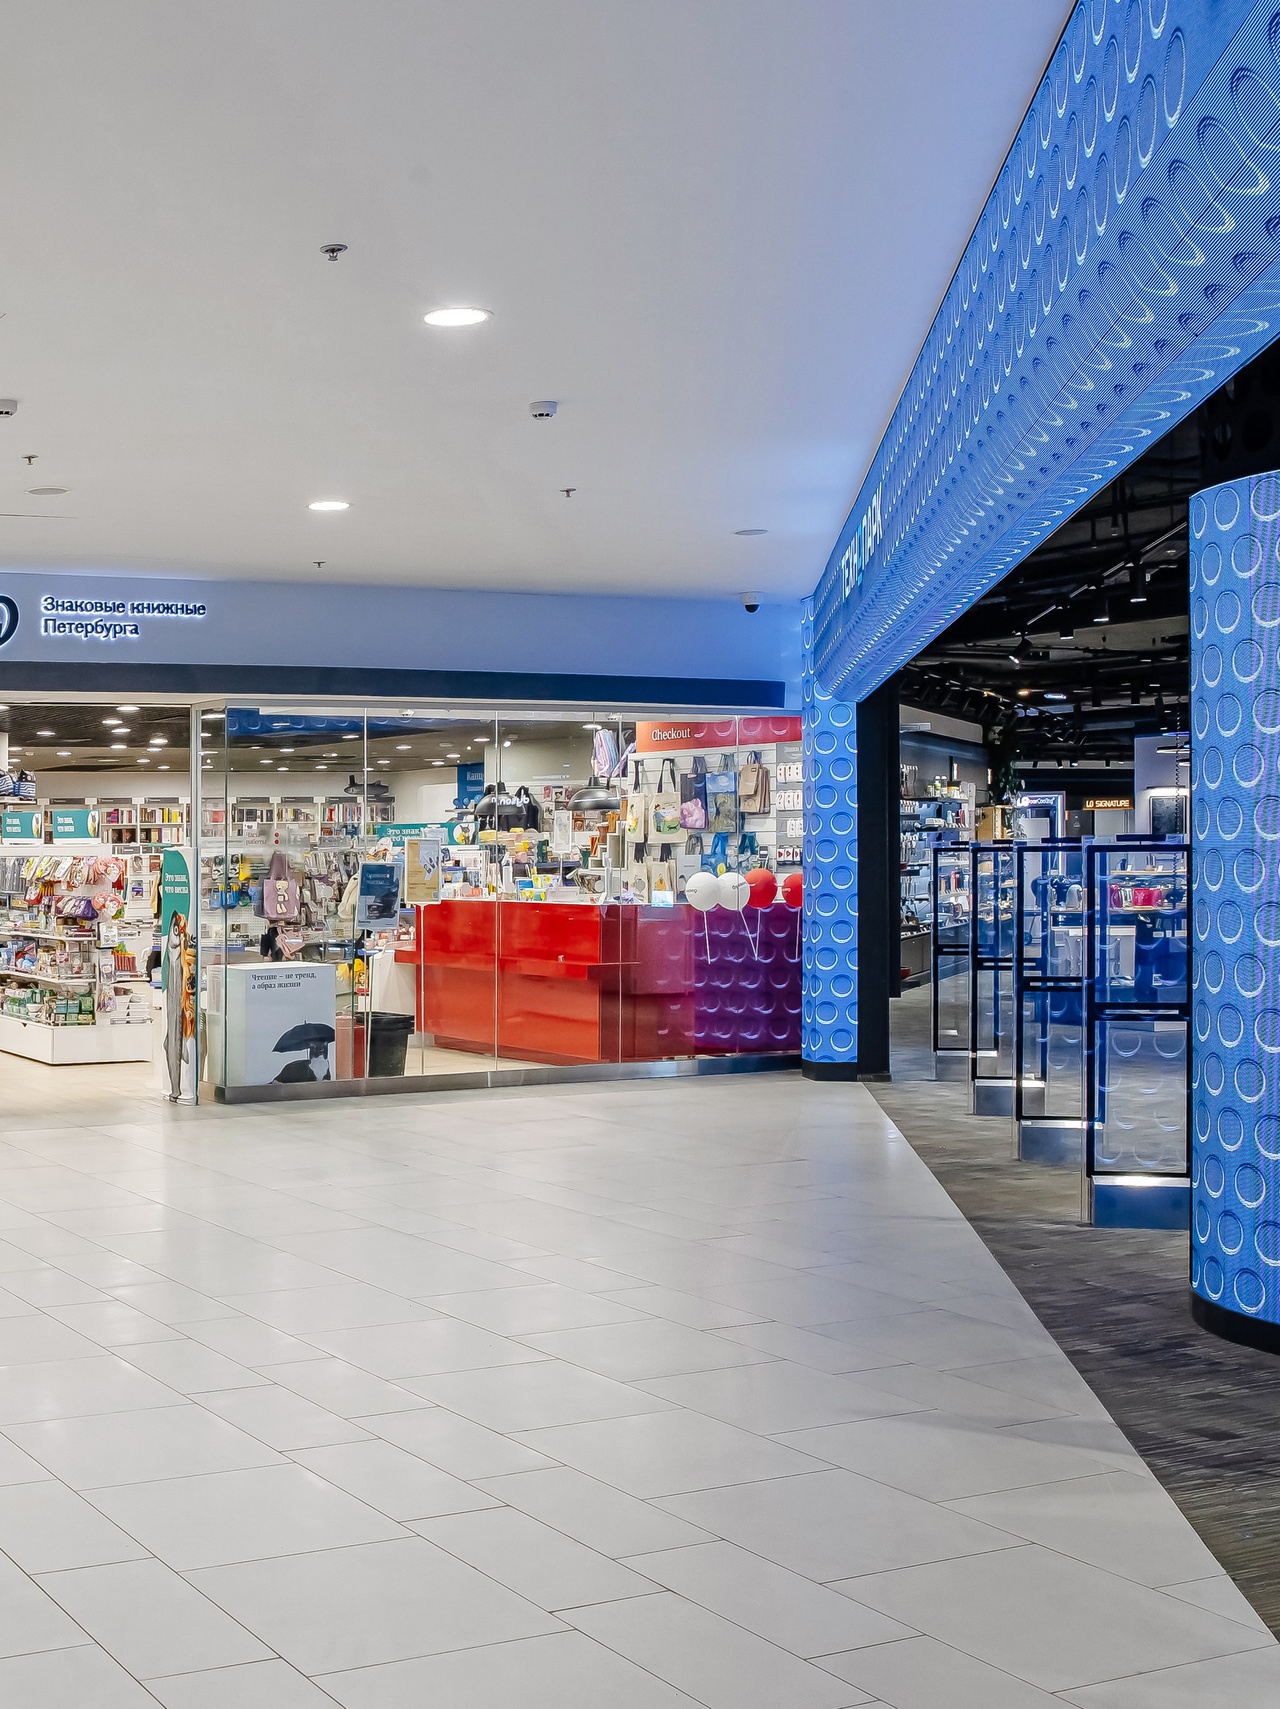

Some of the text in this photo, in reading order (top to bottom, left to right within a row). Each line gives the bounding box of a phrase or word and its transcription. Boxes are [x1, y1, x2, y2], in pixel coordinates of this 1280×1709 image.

[841, 481, 883, 603] ТЕХНОПАРК
[42, 596, 207, 618] Знаковые книжные
[42, 619, 140, 639] Петербурга
[651, 727, 691, 742] Checkout
[1095, 799, 1130, 808] SIGNATURE
[386, 827, 400, 835] Это
[164, 873, 174, 882] Это
[251, 973, 278, 981] Чтение
[256, 982, 277, 991] образ
